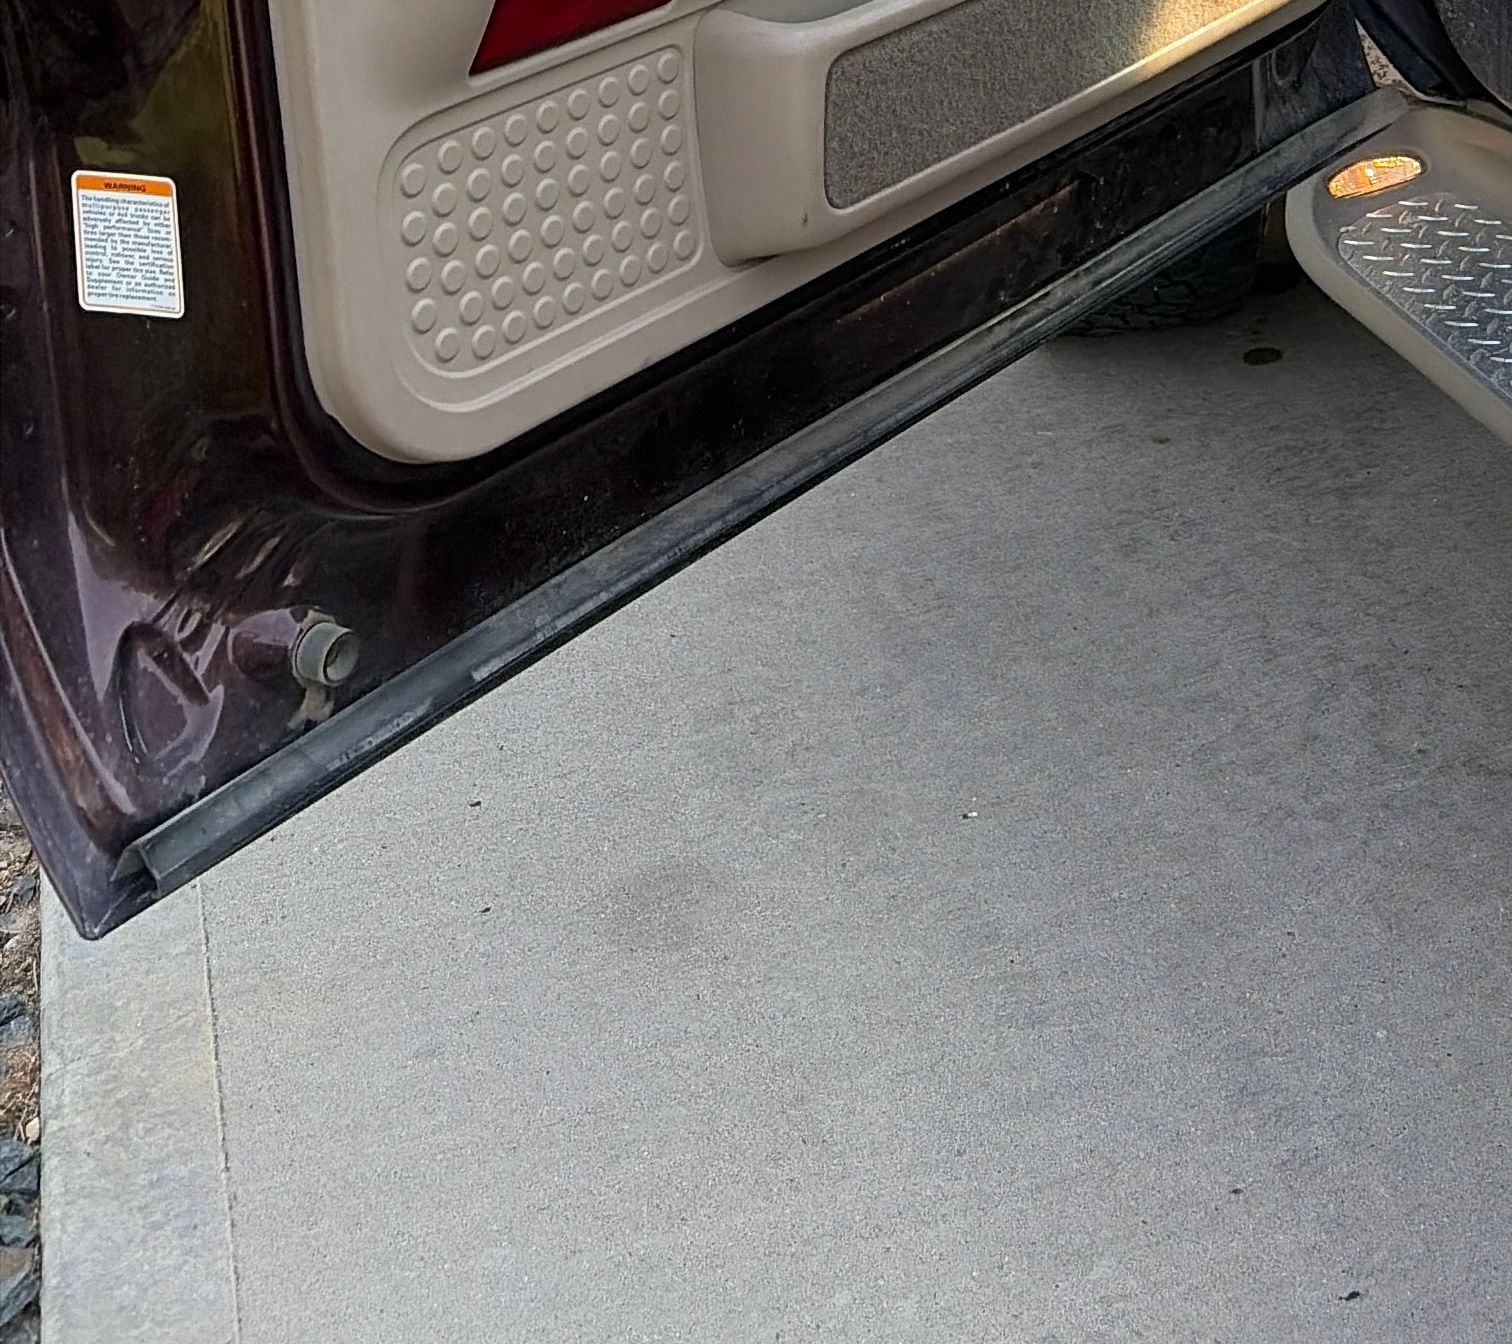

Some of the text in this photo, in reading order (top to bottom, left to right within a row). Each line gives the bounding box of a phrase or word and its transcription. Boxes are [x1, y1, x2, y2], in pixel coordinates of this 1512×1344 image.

[103, 182, 146, 192] WARNING
[120, 198, 163, 206] characteristics
[82, 202, 129, 211] multipurpose
[83, 216, 111, 224] adversely
[122, 246, 147, 254] possible
[87, 277, 123, 286] Supplement
